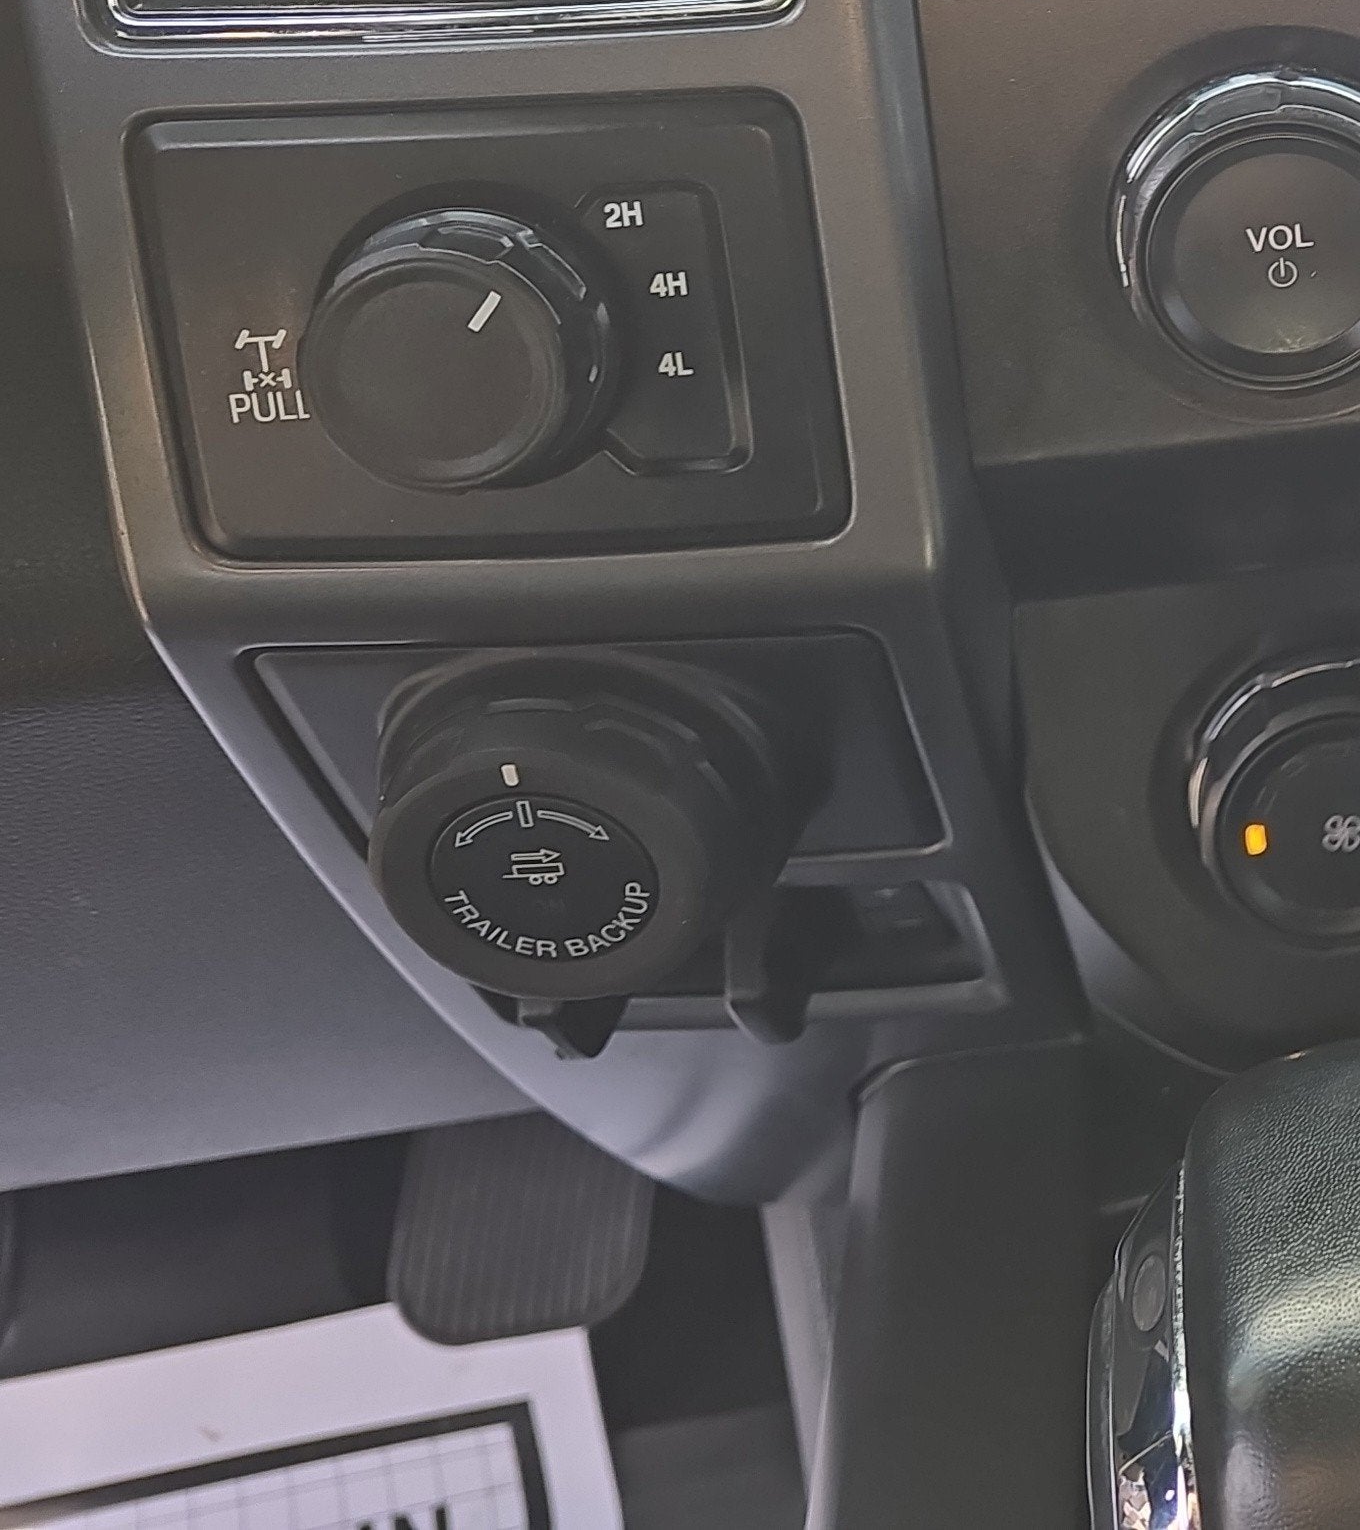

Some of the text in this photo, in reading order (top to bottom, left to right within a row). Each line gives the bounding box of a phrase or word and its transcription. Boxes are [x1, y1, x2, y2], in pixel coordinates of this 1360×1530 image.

[603, 201, 643, 229] 2H
[1246, 223, 1315, 253] VOL
[650, 272, 688, 297] 4H
[658, 353, 694, 376] 4L
[229, 391, 310, 423] PULL
[444, 881, 651, 958] TRAILER BACKUP
